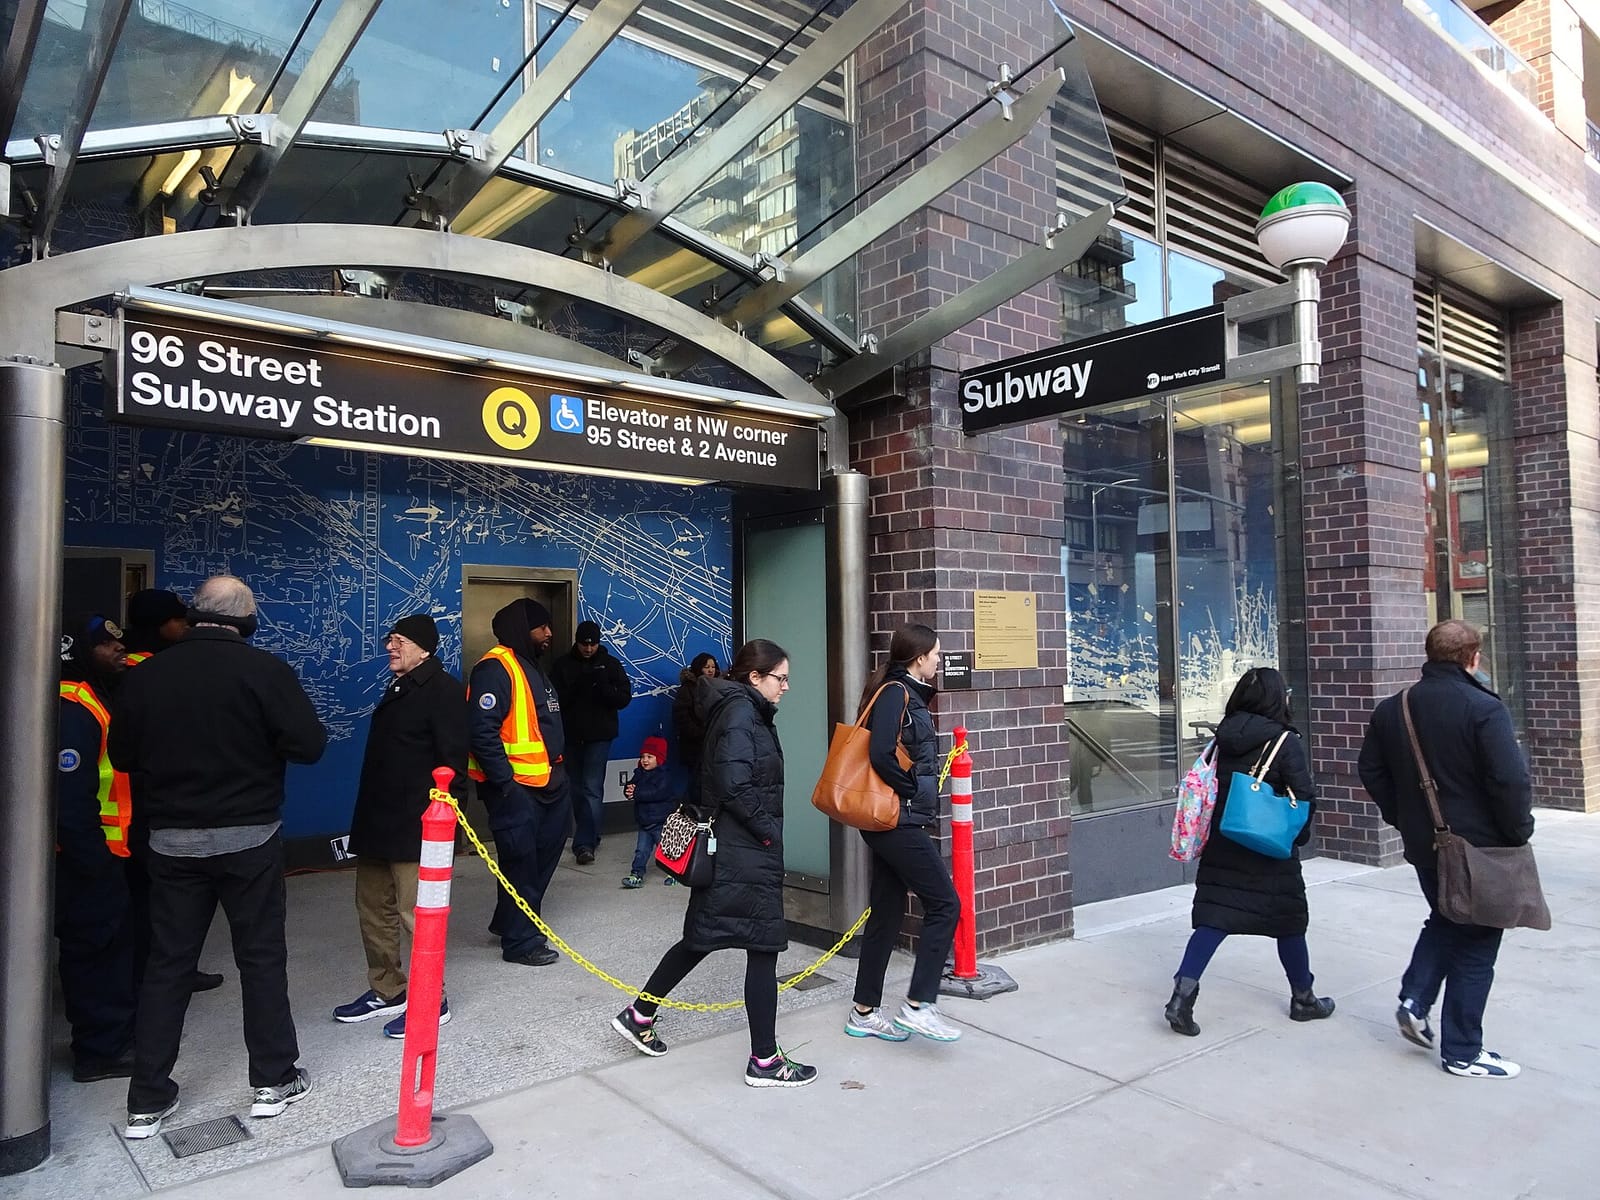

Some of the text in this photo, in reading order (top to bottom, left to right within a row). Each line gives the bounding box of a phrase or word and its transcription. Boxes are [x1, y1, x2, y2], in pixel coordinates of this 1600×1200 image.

[130, 331, 323, 388] 96 Street
[1174, 371, 1187, 379] York
[1200, 364, 1220, 374] Transit
[130, 371, 441, 439] Subway Station
[963, 359, 1094, 413] Subway
[496, 400, 527, 439] Q
[587, 399, 788, 446] Elevator at NW corner
[587, 424, 778, 467] 95 Street & 2 Avenue
